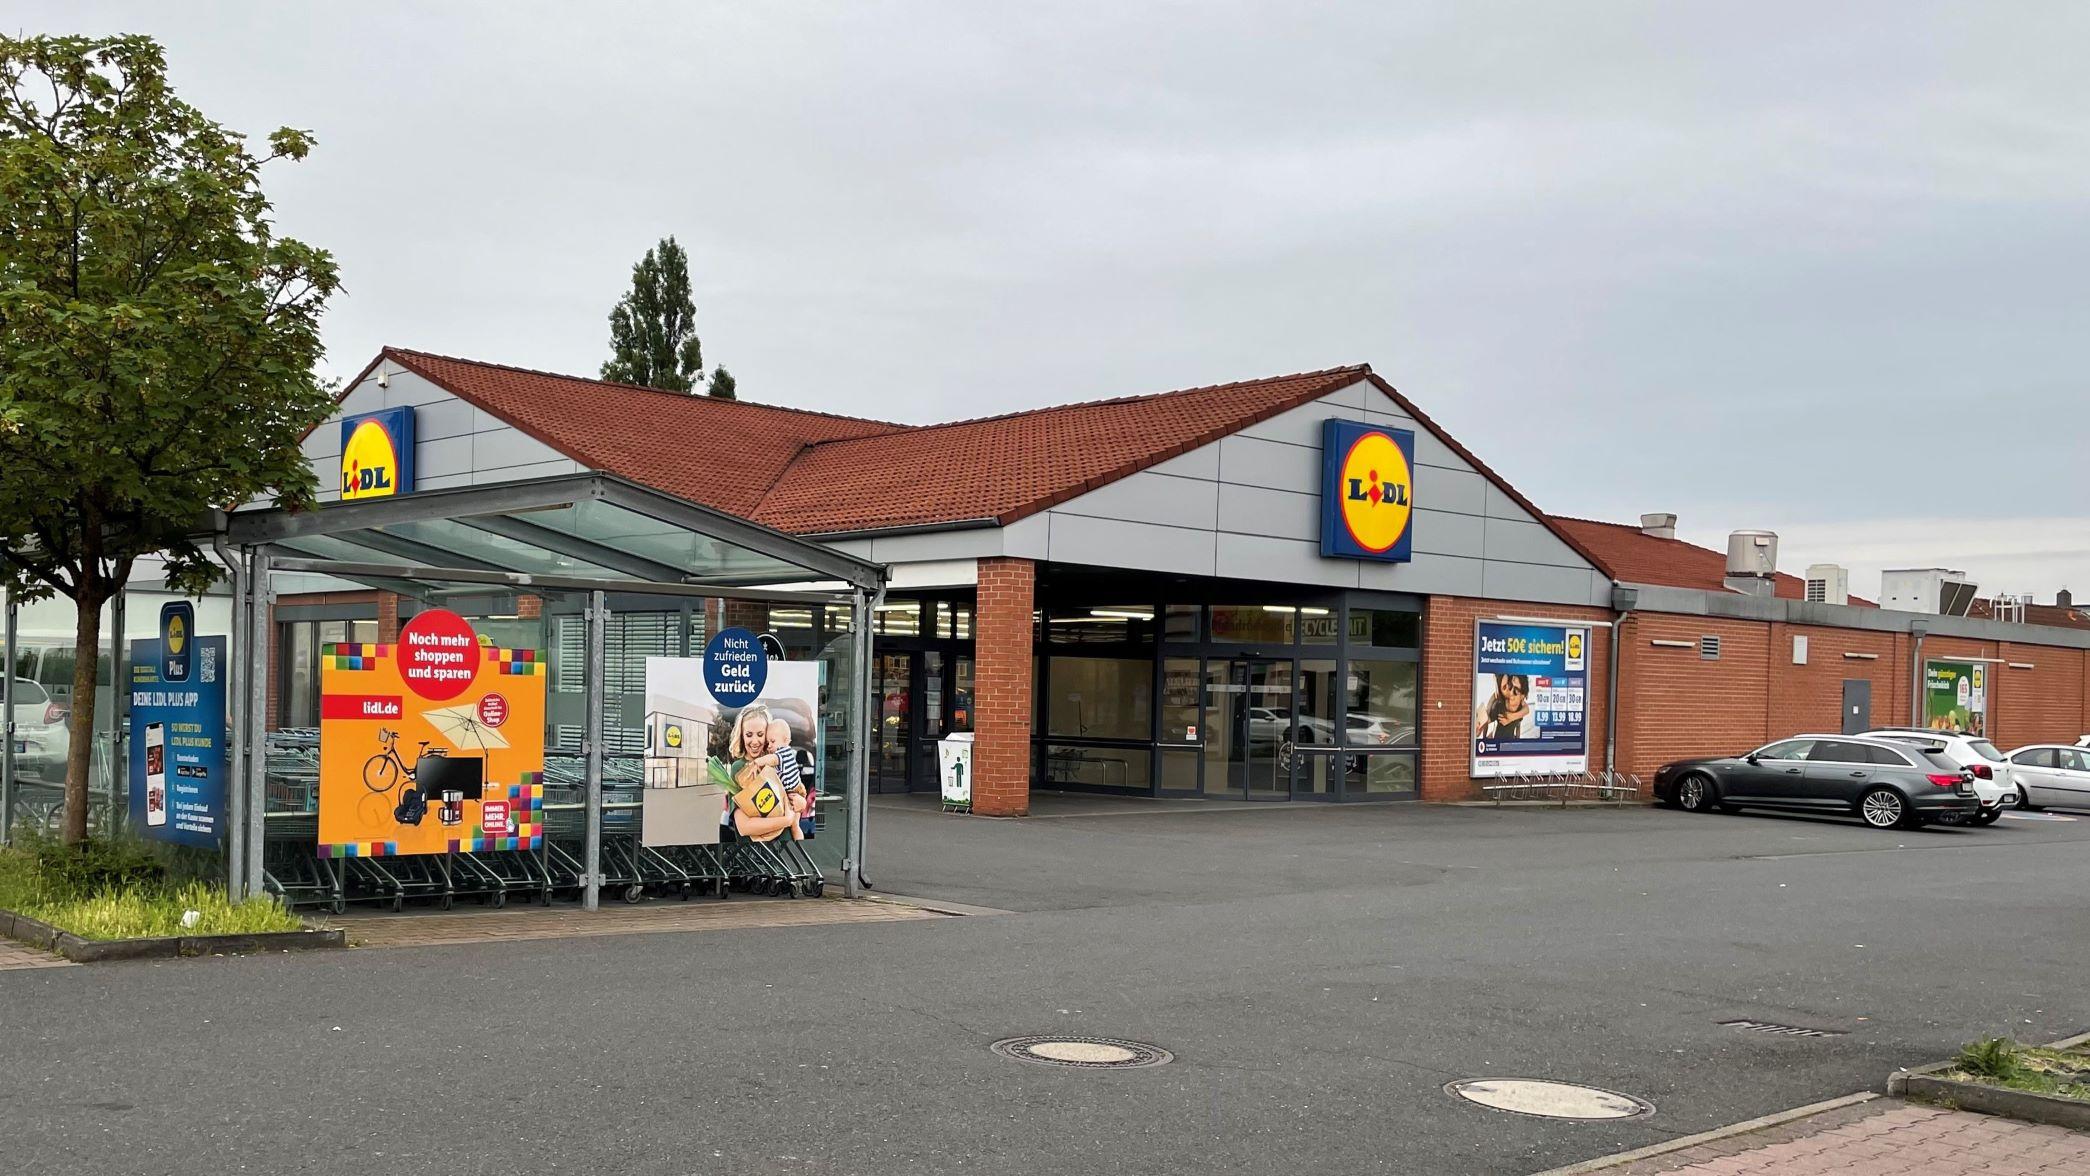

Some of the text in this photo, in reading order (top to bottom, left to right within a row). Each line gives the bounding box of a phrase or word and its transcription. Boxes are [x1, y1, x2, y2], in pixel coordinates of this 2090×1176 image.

[343, 459, 390, 497] LIDL
[1347, 469, 1408, 508] LIDL
[408, 632, 471, 647] Noch mehr
[724, 637, 749, 649] Nicht
[1481, 636, 1565, 655] Jetzt 50€ sichern!
[414, 649, 464, 665] shoppen
[713, 649, 758, 662] zufrieden
[168, 660, 183, 676] Plus
[408, 665, 472, 681] und sparen
[721, 663, 750, 677] Geld
[714, 680, 756, 693] zurück
[133, 692, 199, 707] DEINE LIDL PLUS APP
[363, 701, 399, 715] lidl.de
